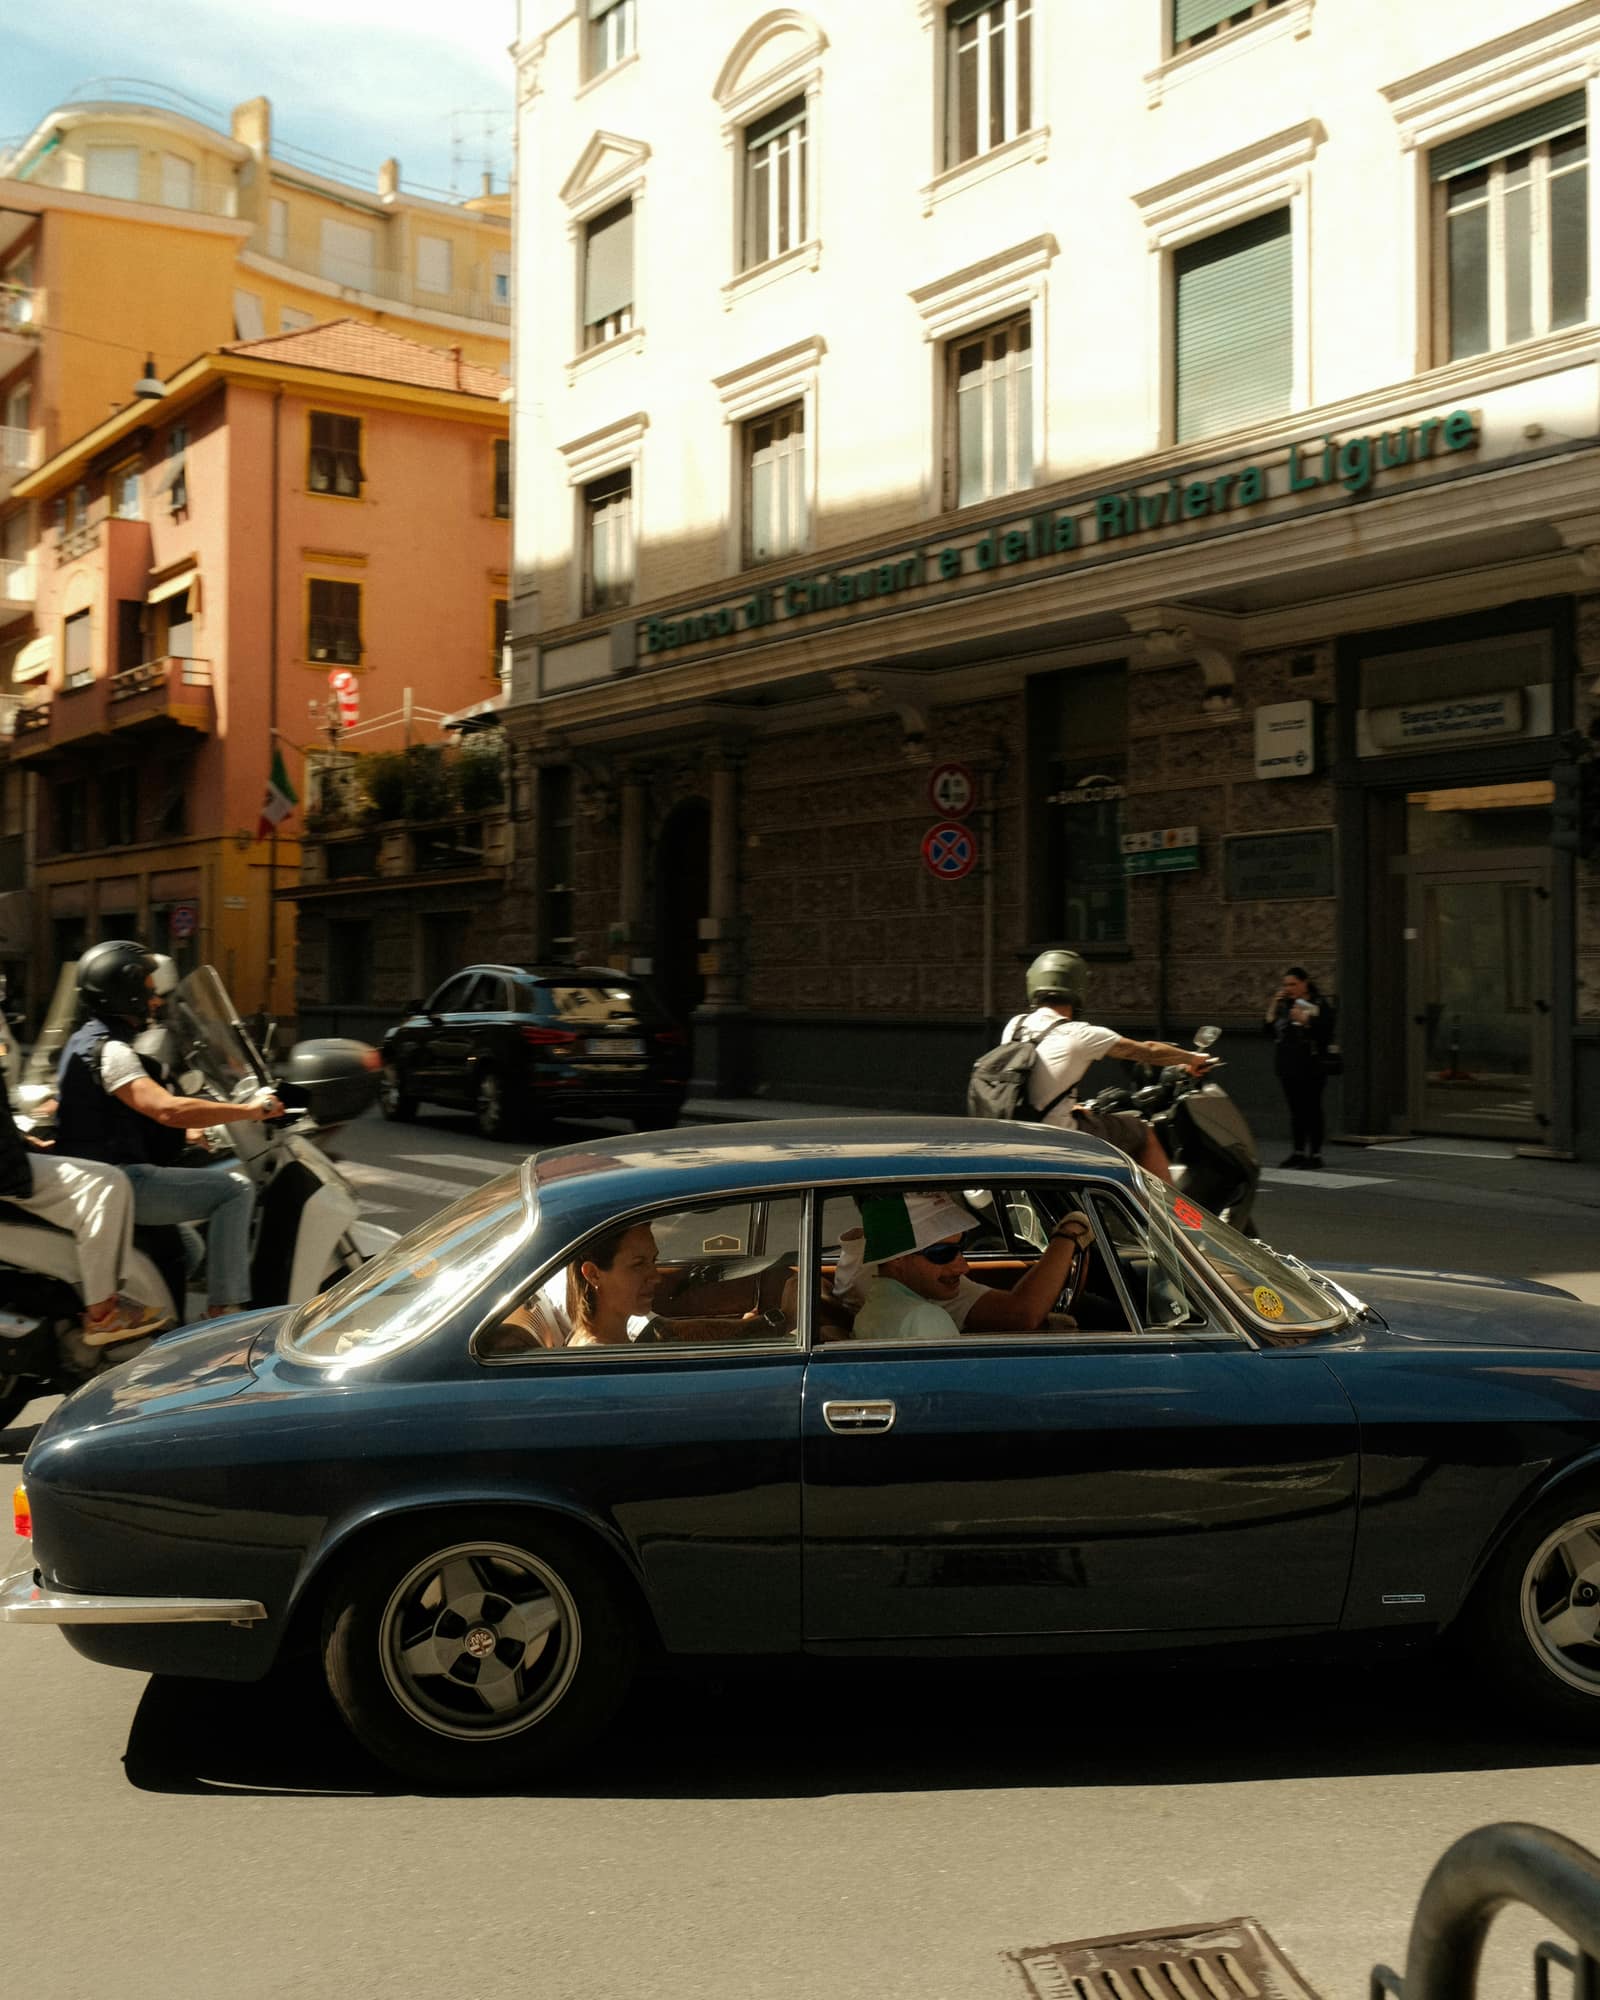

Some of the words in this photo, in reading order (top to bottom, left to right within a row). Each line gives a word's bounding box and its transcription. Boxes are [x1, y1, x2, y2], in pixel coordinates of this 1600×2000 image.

[645, 607, 735, 654] Banco
[745, 588, 773, 627] di
[783, 551, 926, 618] Chiavari
[938, 546, 961, 579] e
[976, 512, 1078, 571] della
[1095, 465, 1263, 541] Riviera
[1288, 409, 1476, 493] Ligure
